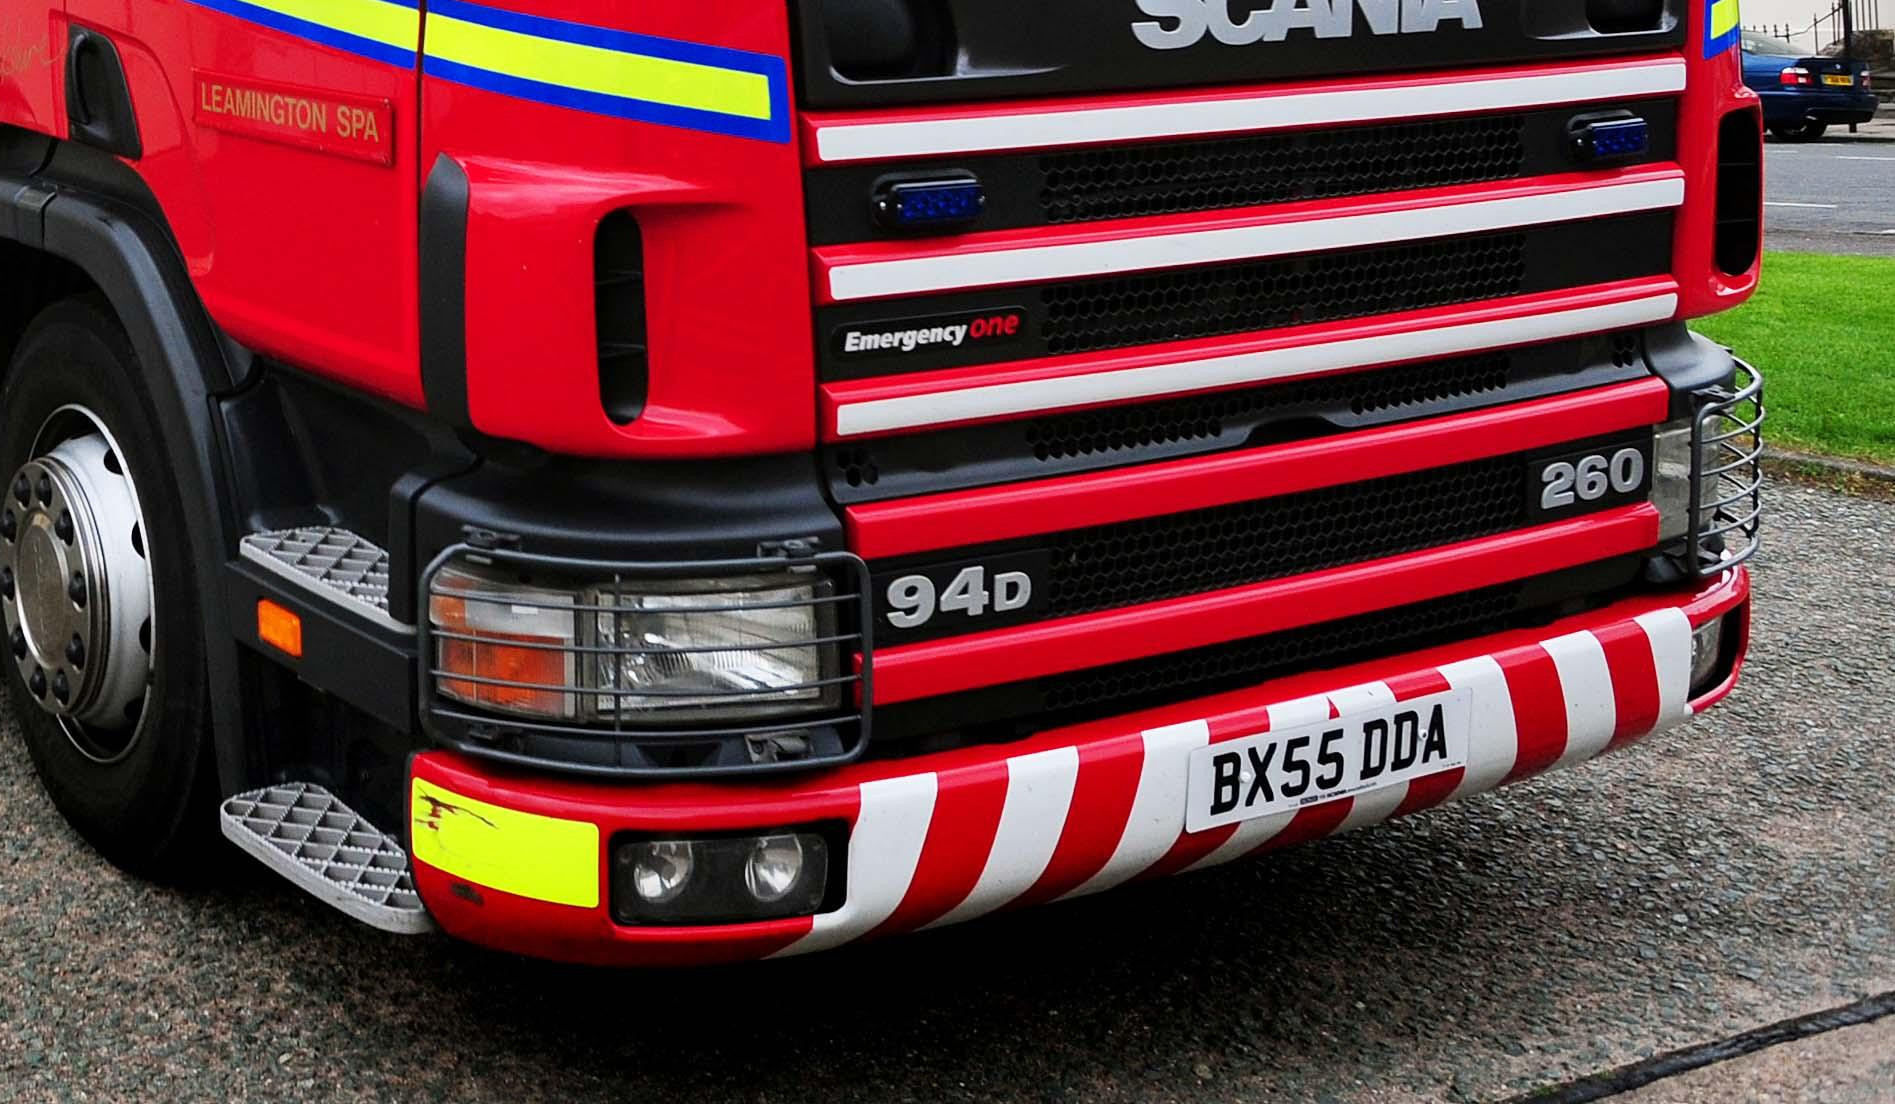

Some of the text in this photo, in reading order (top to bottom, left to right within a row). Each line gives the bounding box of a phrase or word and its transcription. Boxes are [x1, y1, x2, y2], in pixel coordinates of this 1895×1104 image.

[201, 82, 379, 143] LEAMINGTON SPA
[844, 314, 1019, 352] Emergency one
[1540, 447, 1644, 509] 260
[886, 565, 1032, 629] 94D
[1210, 703, 1448, 816] BX55 DDA
